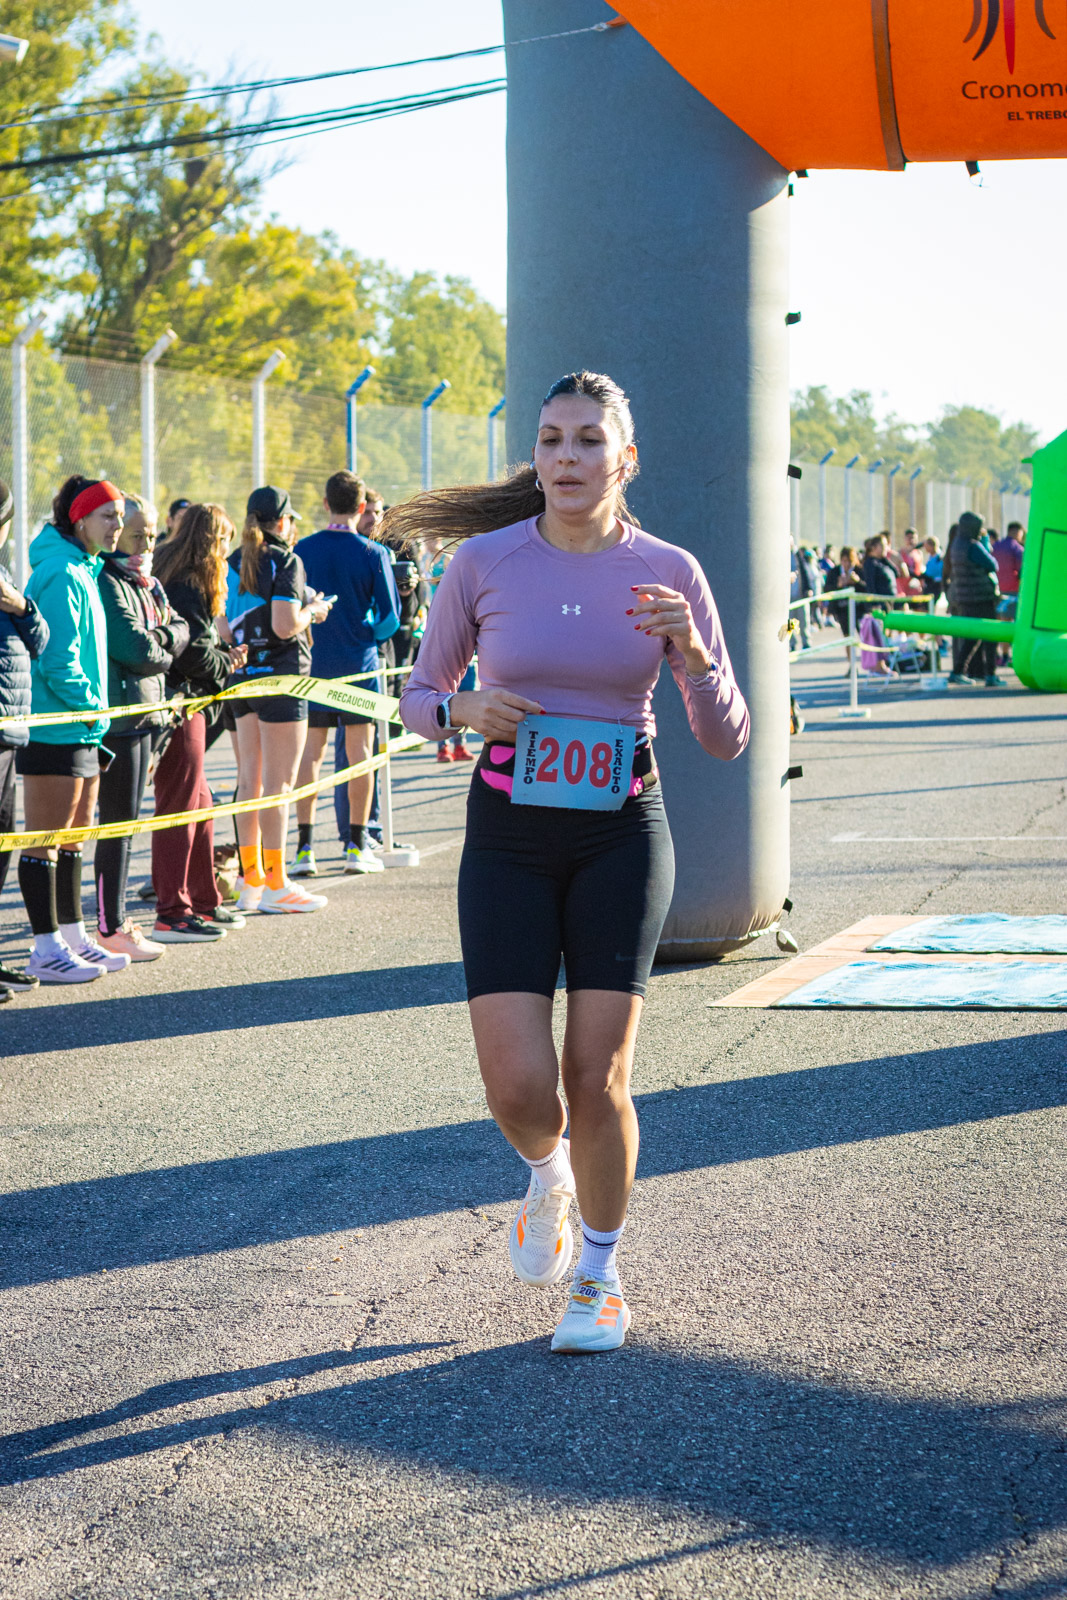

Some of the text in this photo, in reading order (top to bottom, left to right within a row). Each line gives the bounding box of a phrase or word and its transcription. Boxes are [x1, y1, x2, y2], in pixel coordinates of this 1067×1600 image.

[961, 81, 1067, 100] Cronom
[1007, 111, 1024, 121] EL
[326, 689, 377, 712] PRECAUCION
[523, 730, 539, 785] TIEMPO
[536, 736, 613, 789] 208
[611, 739, 624, 794] EXACTO
[579, 1286, 598, 1298] 208
